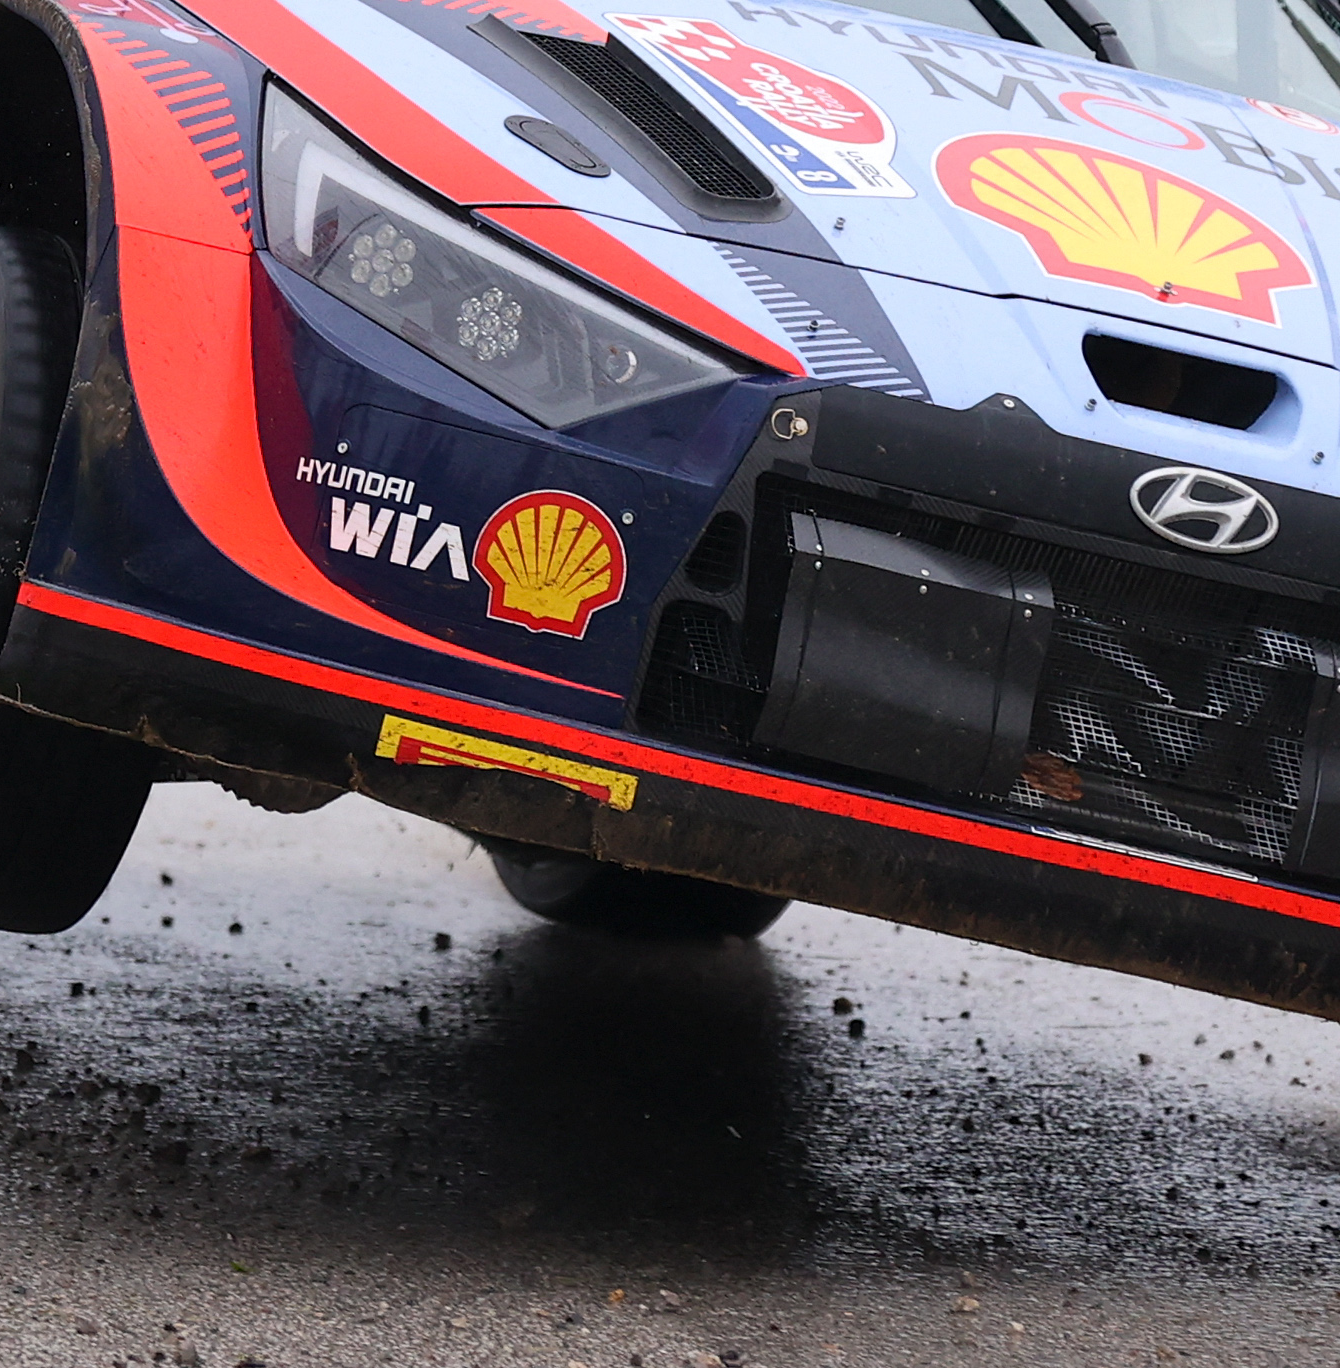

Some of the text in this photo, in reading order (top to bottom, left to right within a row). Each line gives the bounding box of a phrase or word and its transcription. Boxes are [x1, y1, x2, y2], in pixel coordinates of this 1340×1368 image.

[726, 0, 1170, 109] HYUNDAI
[739, 76, 818, 129] RALLY
[749, 61, 861, 130] CROATIA
[805, 84, 846, 111] 2022
[795, 169, 838, 183] 8
[846, 151, 894, 188] WRC
[296, 457, 415, 504] HYUNDAI
[329, 496, 470, 582] WIA
